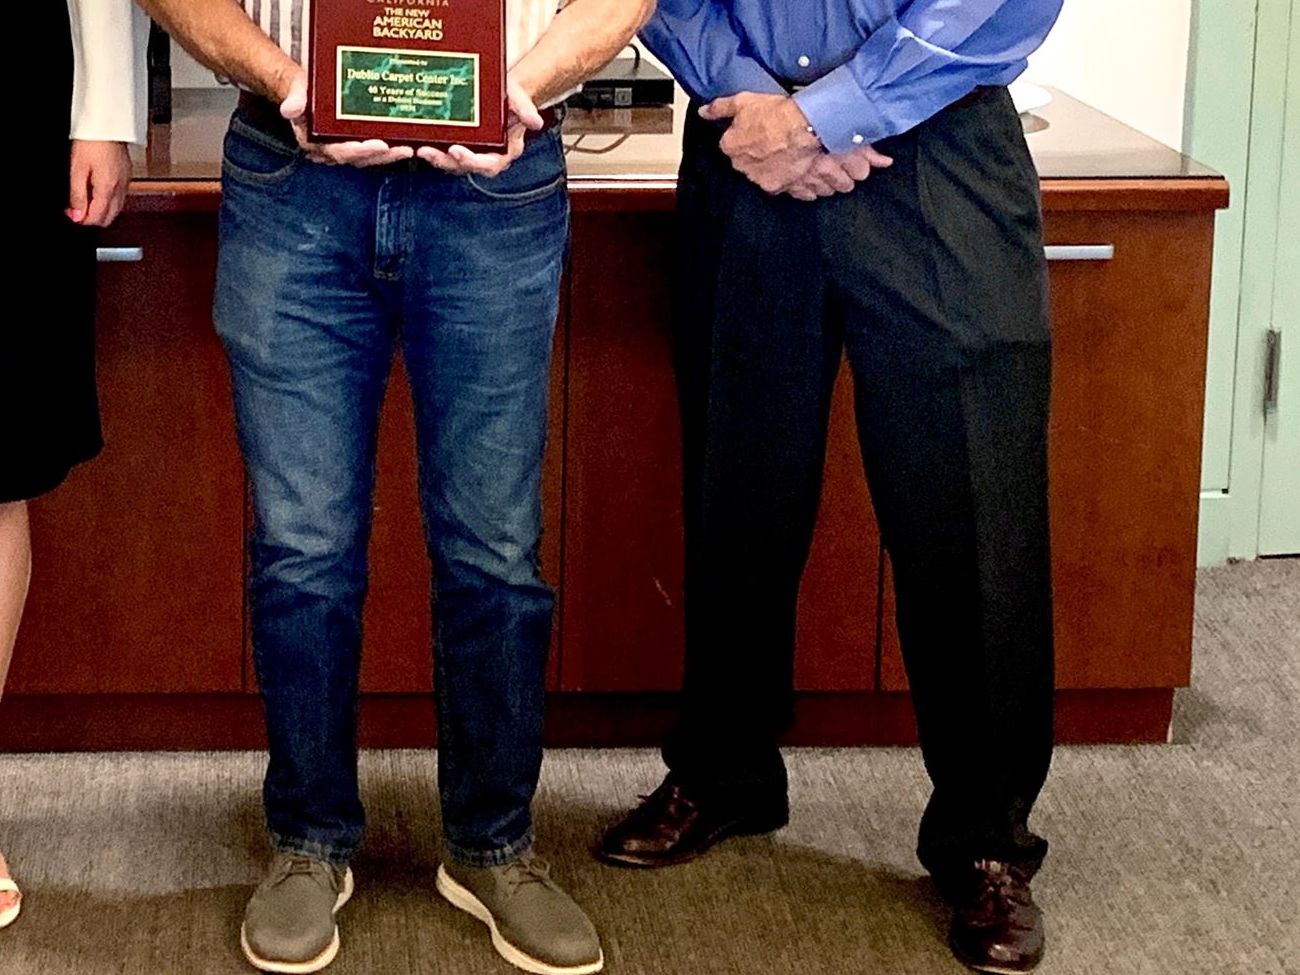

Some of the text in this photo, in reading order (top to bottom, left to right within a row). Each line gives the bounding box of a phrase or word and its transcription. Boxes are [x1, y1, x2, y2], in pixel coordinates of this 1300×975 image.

[384, 7, 430, 18] THE NEW
[373, 15, 442, 30] AMERICAN
[372, 26, 444, 41] BACKYARD
[347, 68, 380, 81] Dublin
[381, 70, 413, 83] Carpet
[415, 72, 448, 85] Center
